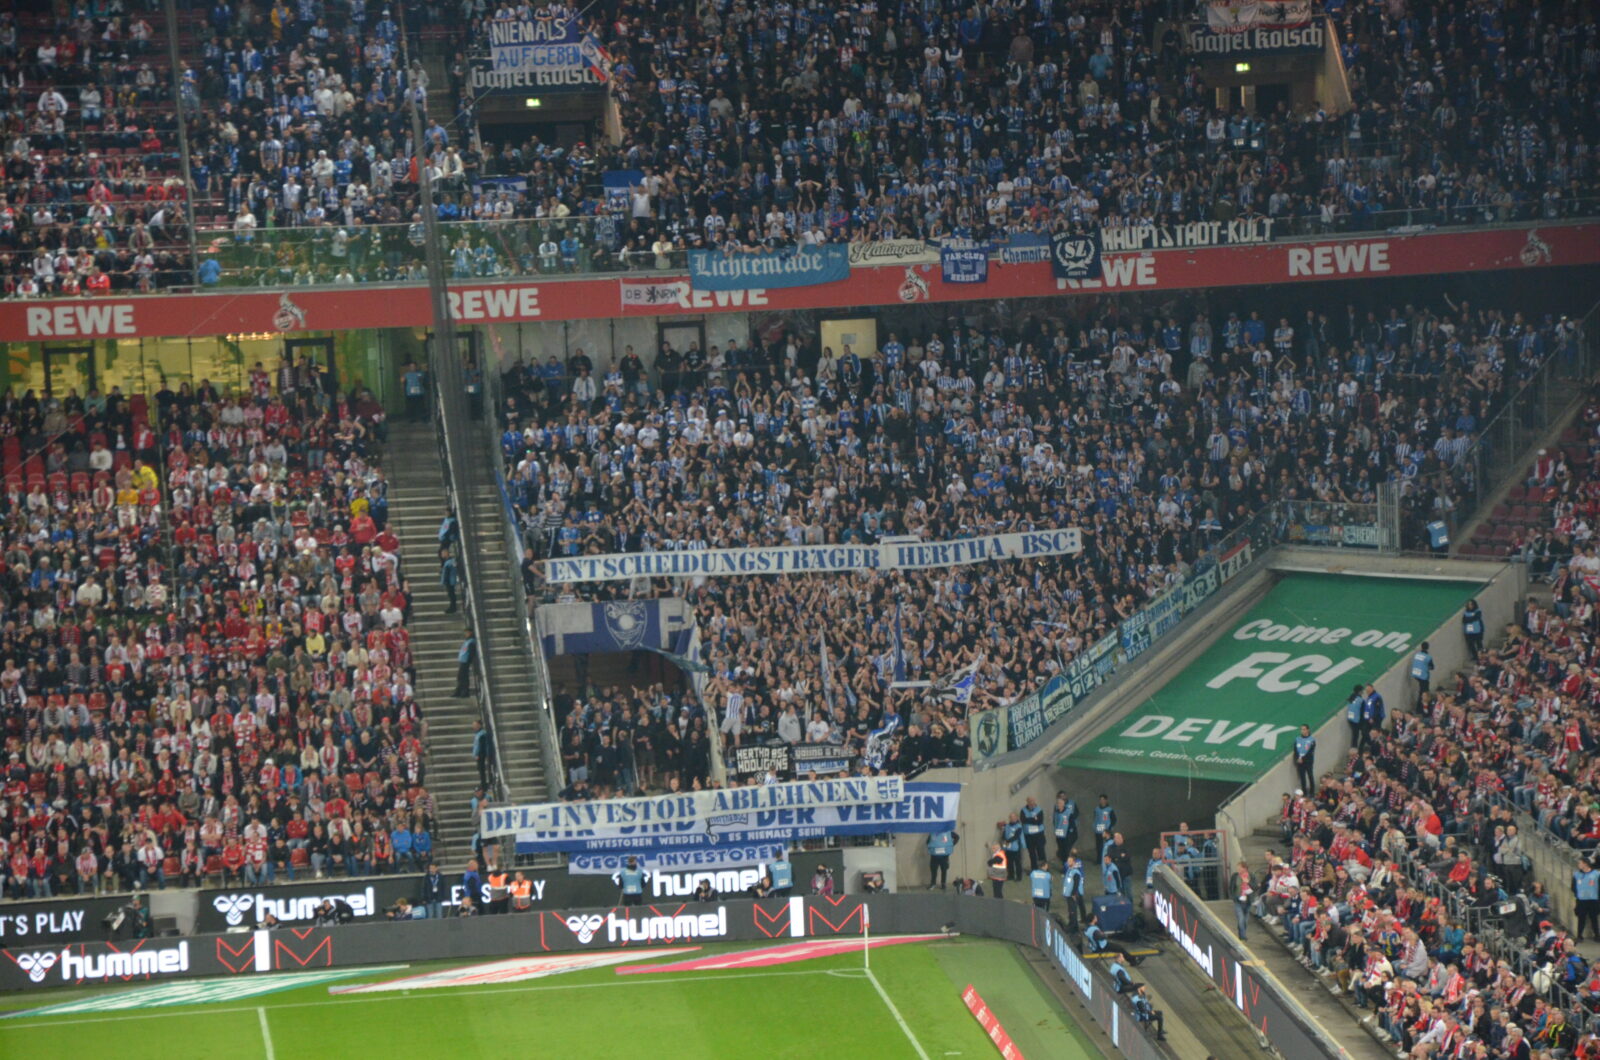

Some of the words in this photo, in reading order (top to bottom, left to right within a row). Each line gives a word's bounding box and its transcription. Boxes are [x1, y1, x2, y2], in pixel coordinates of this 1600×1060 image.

[492, 19, 567, 45] NIEMALS
[496, 45, 580, 68] AUFGEBEN
[1064, 240, 1087, 259] SZ
[1101, 218, 1275, 251] HAUPTSTADT-KULT
[1288, 243, 1390, 276] REWE
[441, 287, 541, 319] REWE
[677, 281, 768, 308] REWE
[26, 304, 136, 336] REWE
[549, 546, 880, 580] ENTSCHEIDUNGSTRÄGER
[897, 538, 1005, 566] HERTHA
[1021, 531, 1076, 555] BSC:
[1233, 619, 1353, 645] Come
[1350, 628, 1412, 653] on,
[1205, 651, 1365, 696] FC!
[1118, 715, 1300, 751] DEVK
[736, 747, 770, 760] HERTHA
[771, 746, 788, 759] BSC
[1098, 746, 1145, 758] Gesagt.
[1149, 750, 1190, 761] Getan.
[1194, 754, 1256, 767] Geholfen.
[485, 796, 697, 831] DFL-INVESTOR
[711, 779, 868, 811] ABLEHNEN!
[756, 807, 815, 827] DER
[836, 795, 944, 822] VEREIN
[586, 838, 653, 849] INVESTOREN
[659, 834, 703, 845] WERDEN
[747, 828, 792, 840] NIEMALS
[575, 854, 646, 870] GEGEN
[656, 843, 784, 866] INVESTOREN
[35, 910, 85, 934] PLAY
[607, 906, 727, 942] hummel
[61, 940, 189, 980] hummel
